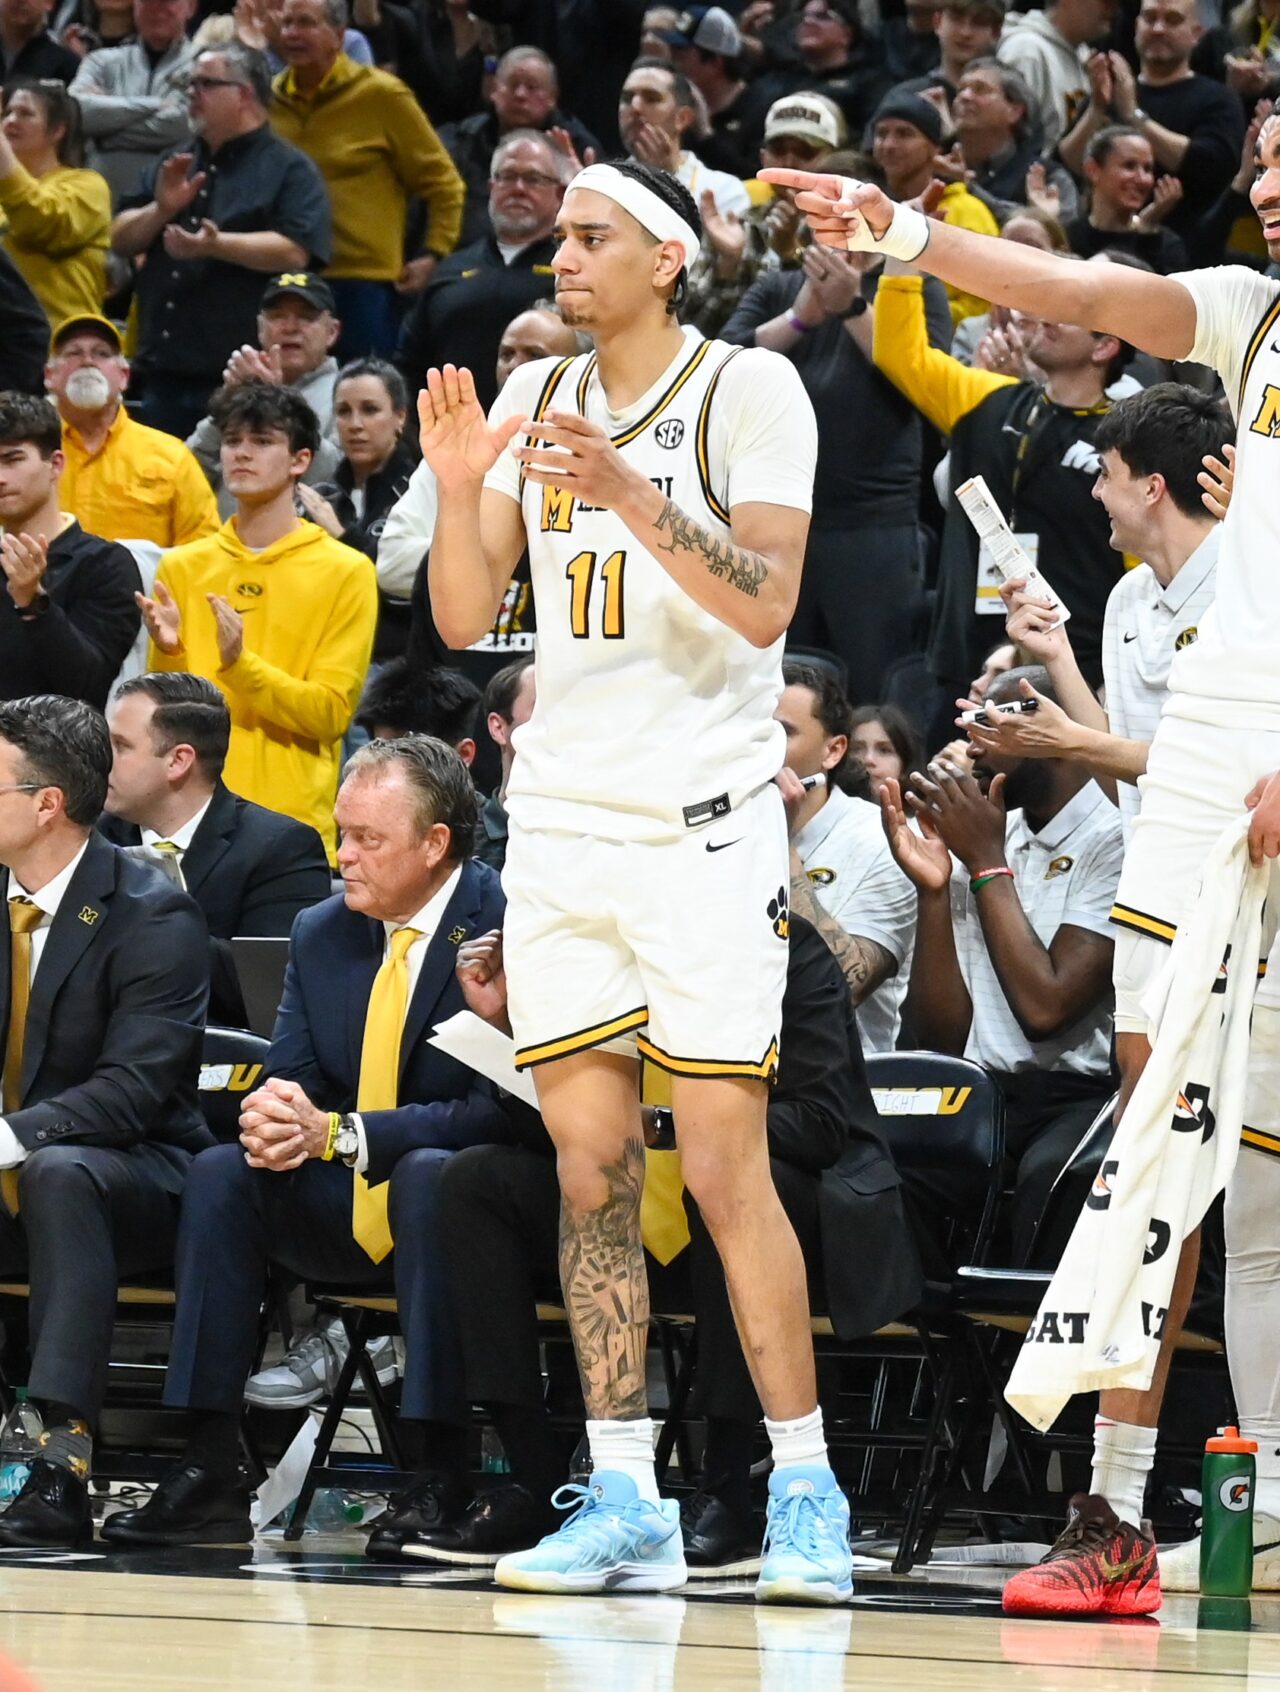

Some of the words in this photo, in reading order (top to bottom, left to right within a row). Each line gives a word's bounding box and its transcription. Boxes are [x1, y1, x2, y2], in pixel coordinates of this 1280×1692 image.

[655, 420, 685, 448] SEC
[566, 550, 627, 640] 11
[714, 802, 727, 813] XL
[1220, 1475, 1250, 1512] G
